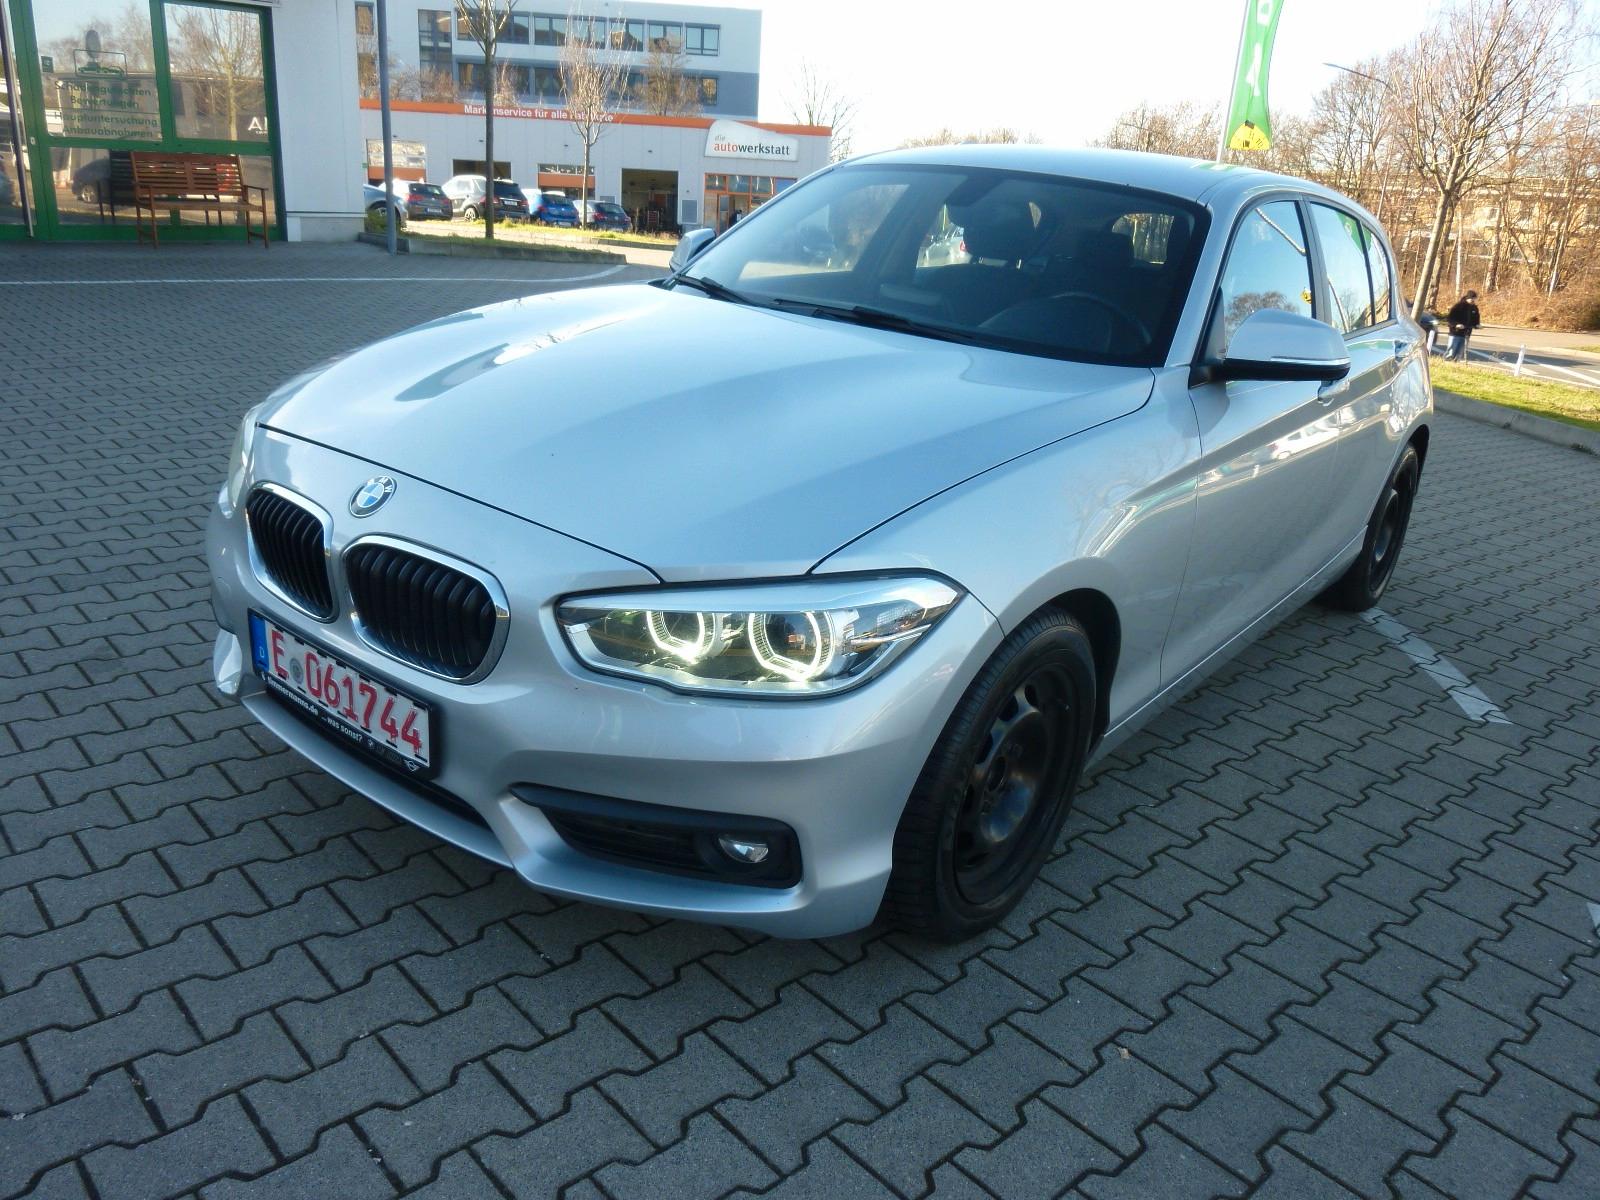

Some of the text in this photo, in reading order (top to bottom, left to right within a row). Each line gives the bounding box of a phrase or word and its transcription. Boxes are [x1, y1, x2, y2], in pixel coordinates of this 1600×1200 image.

[54, 80, 151, 97] Schadguchten
[464, 104, 532, 117] Marknservice
[534, 108, 548, 118] für
[550, 109, 568, 119] alle
[713, 142, 790, 155] autowerkstatt
[271, 630, 422, 754] E 061744
